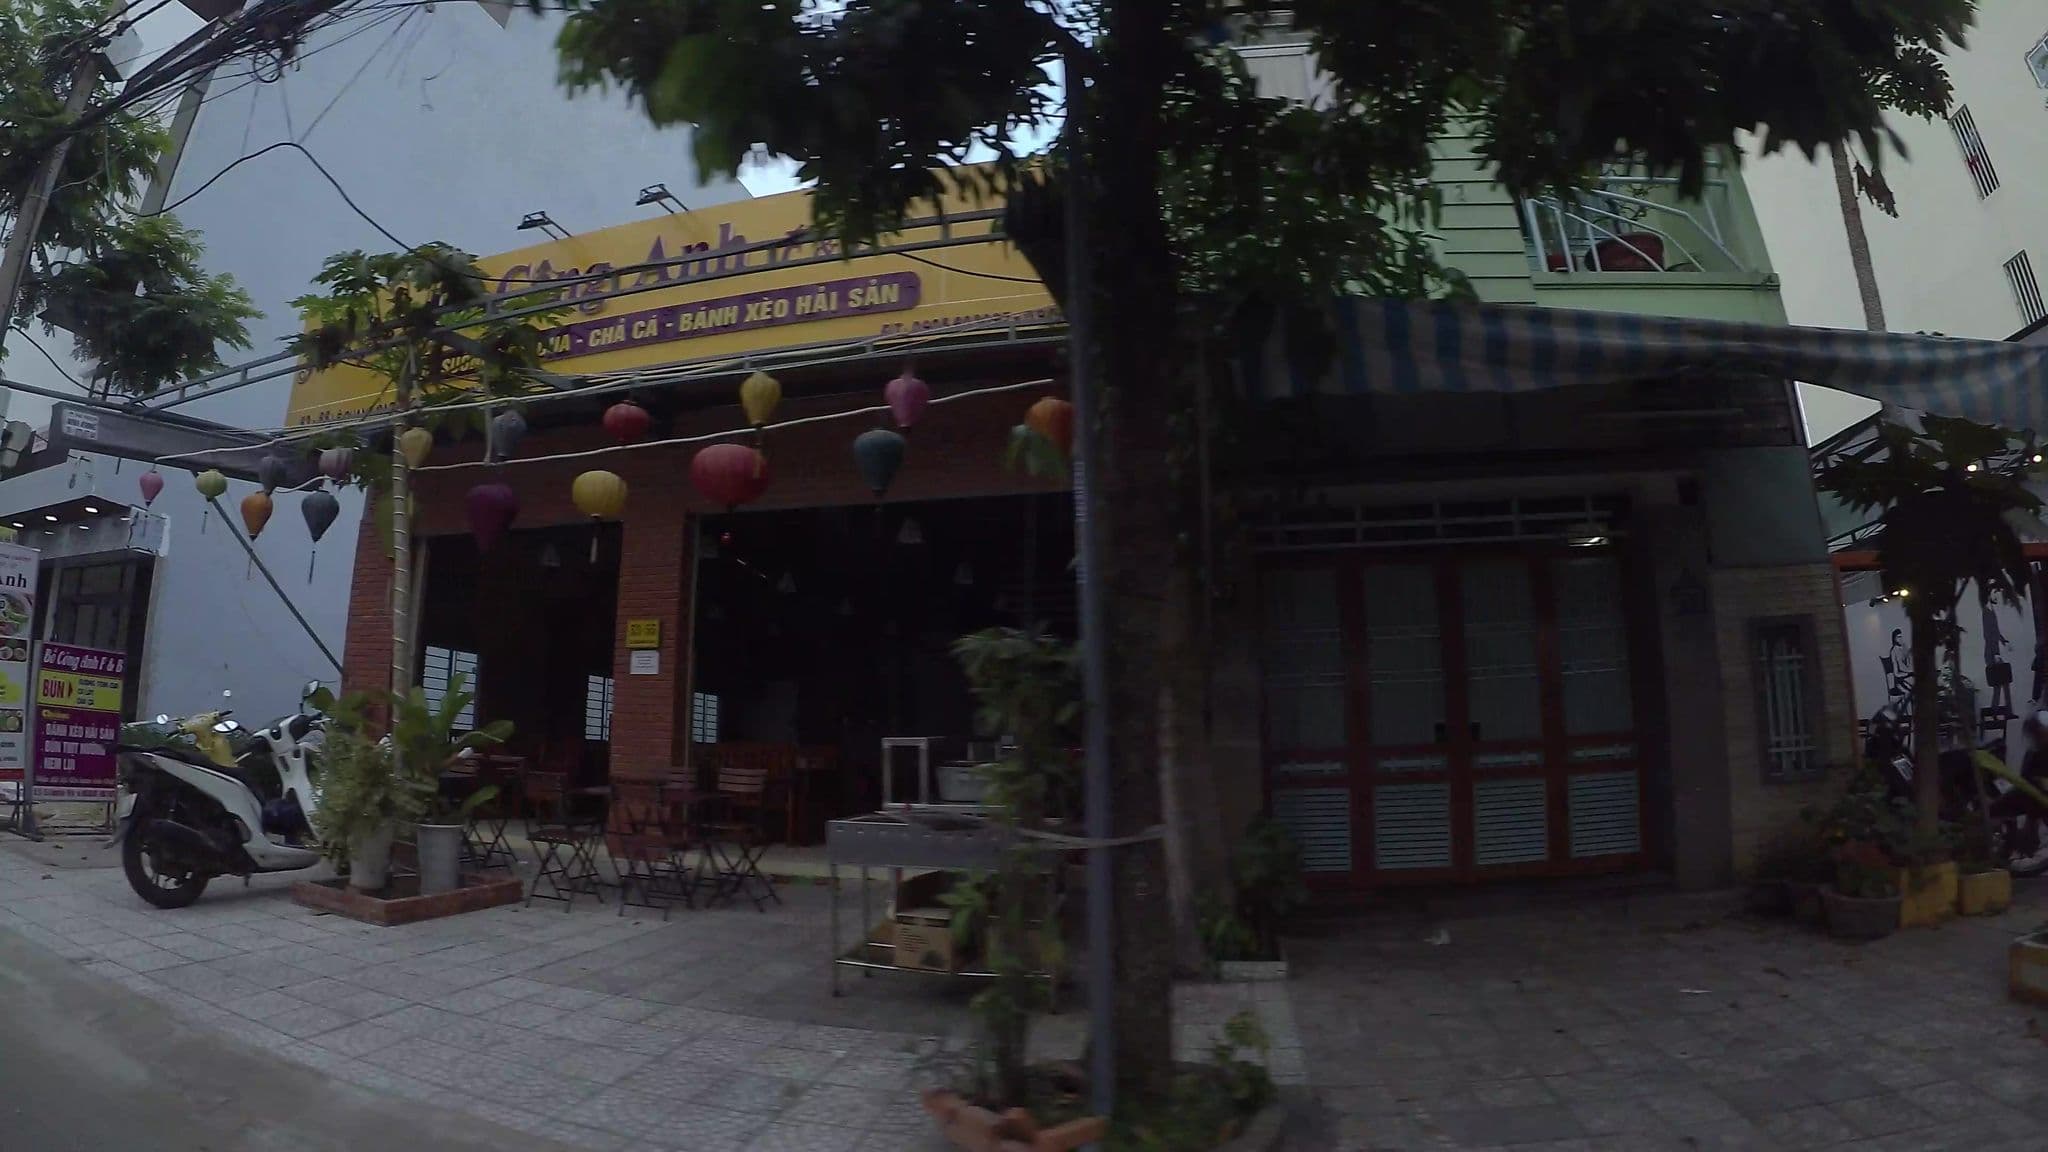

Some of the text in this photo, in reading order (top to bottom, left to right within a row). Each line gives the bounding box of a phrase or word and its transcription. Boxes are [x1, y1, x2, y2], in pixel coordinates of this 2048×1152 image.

[631, 312, 659, 338] CÁ
[679, 304, 739, 333] BÁNH
[743, 295, 789, 323] XÈO
[796, 285, 838, 315] HẢI
[847, 278, 900, 307] SẢN
